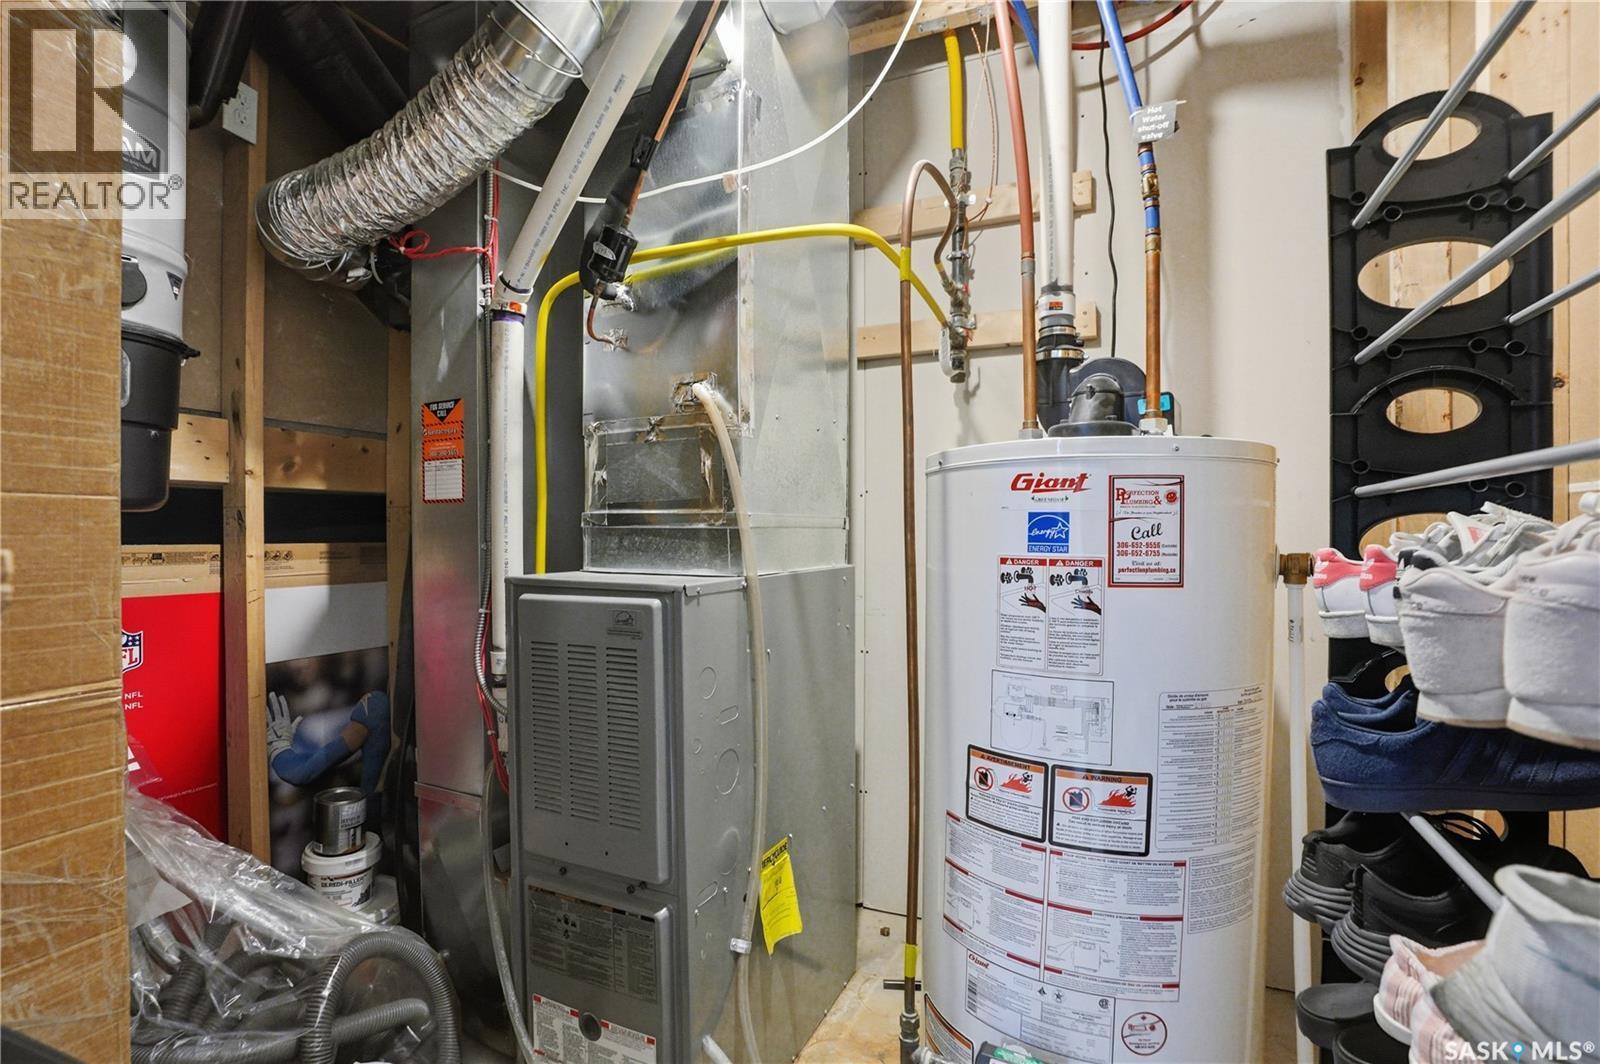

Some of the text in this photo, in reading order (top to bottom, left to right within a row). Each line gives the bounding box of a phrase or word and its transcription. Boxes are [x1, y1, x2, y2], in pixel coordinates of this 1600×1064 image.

[1147, 106, 1162, 114] Hot
[1142, 114, 1167, 123] Water
[1010, 472, 1089, 494] Giant
[1131, 522, 1163, 540] Call
[1065, 560, 1094, 568] DANGER
[124, 690, 144, 700] NFL
[124, 701, 144, 711] NFL
[1090, 776, 1122, 784] WARNING
[968, 953, 990, 969] Giant
